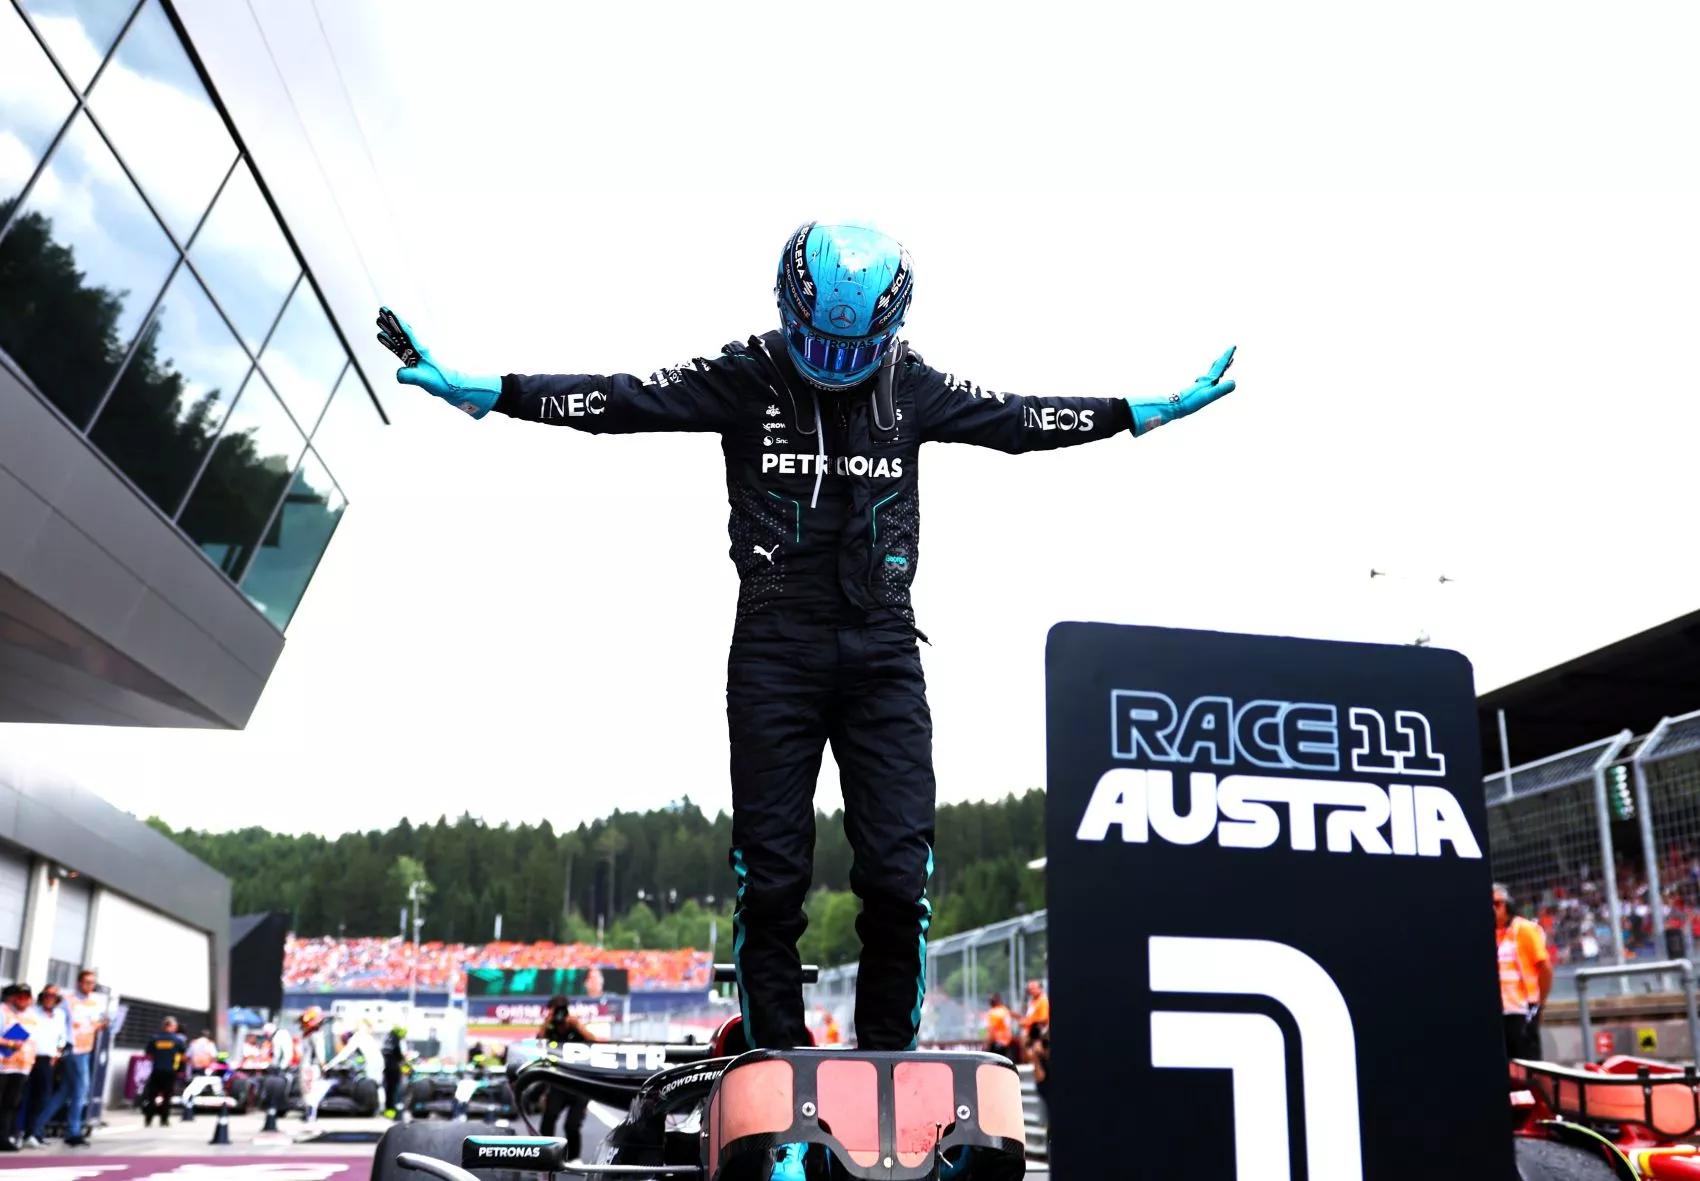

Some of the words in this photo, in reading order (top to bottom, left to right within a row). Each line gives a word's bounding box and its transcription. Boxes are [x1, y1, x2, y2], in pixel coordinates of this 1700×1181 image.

[1023, 405, 1094, 431] INEOS
[762, 454, 902, 478] PETROAS
[1110, 689, 1340, 772] RACE
[1349, 706, 1446, 777] 11
[1076, 767, 1483, 859] AUSTRIA
[478, 1147, 541, 1158] PETRONAS
